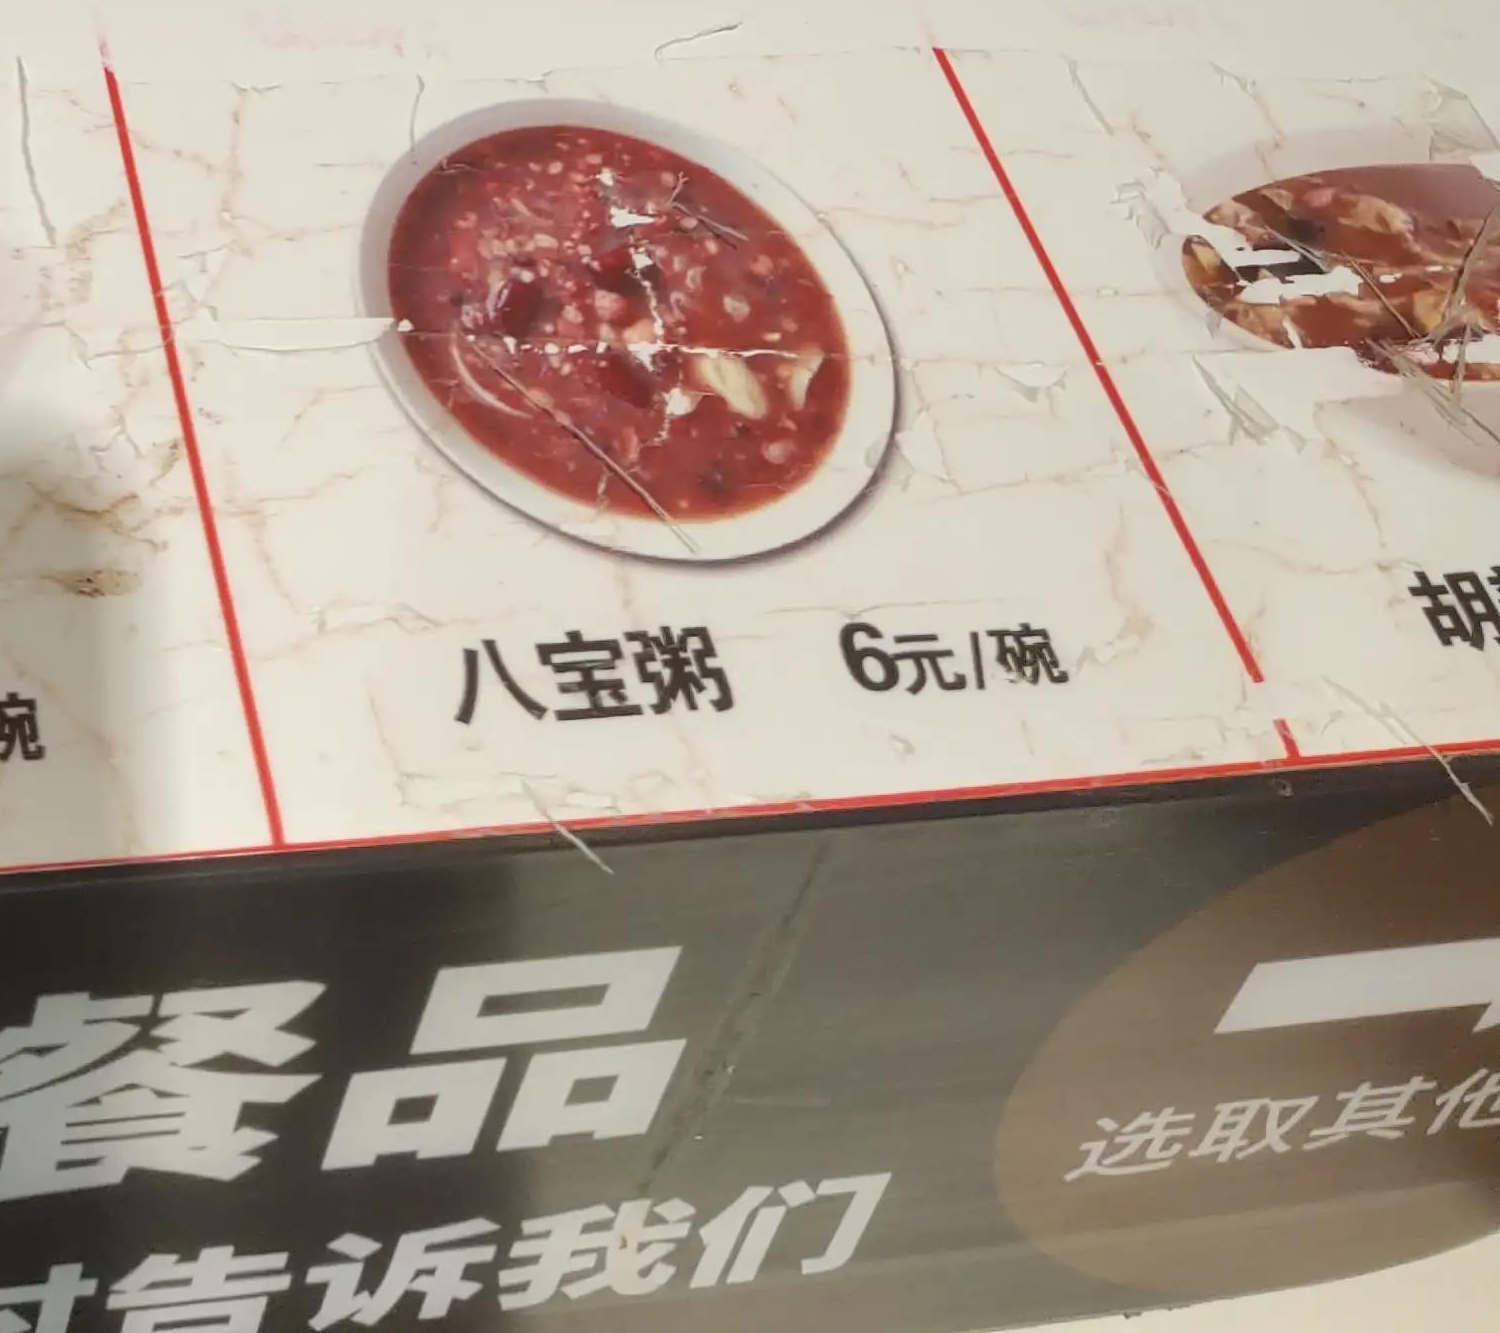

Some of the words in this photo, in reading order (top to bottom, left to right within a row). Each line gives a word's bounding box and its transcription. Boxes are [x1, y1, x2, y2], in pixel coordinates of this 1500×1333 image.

[1407, 565, 1500, 651] 胡
[453, 624, 734, 725] 八宝粥
[838, 620, 1069, 696] 6元/碗
